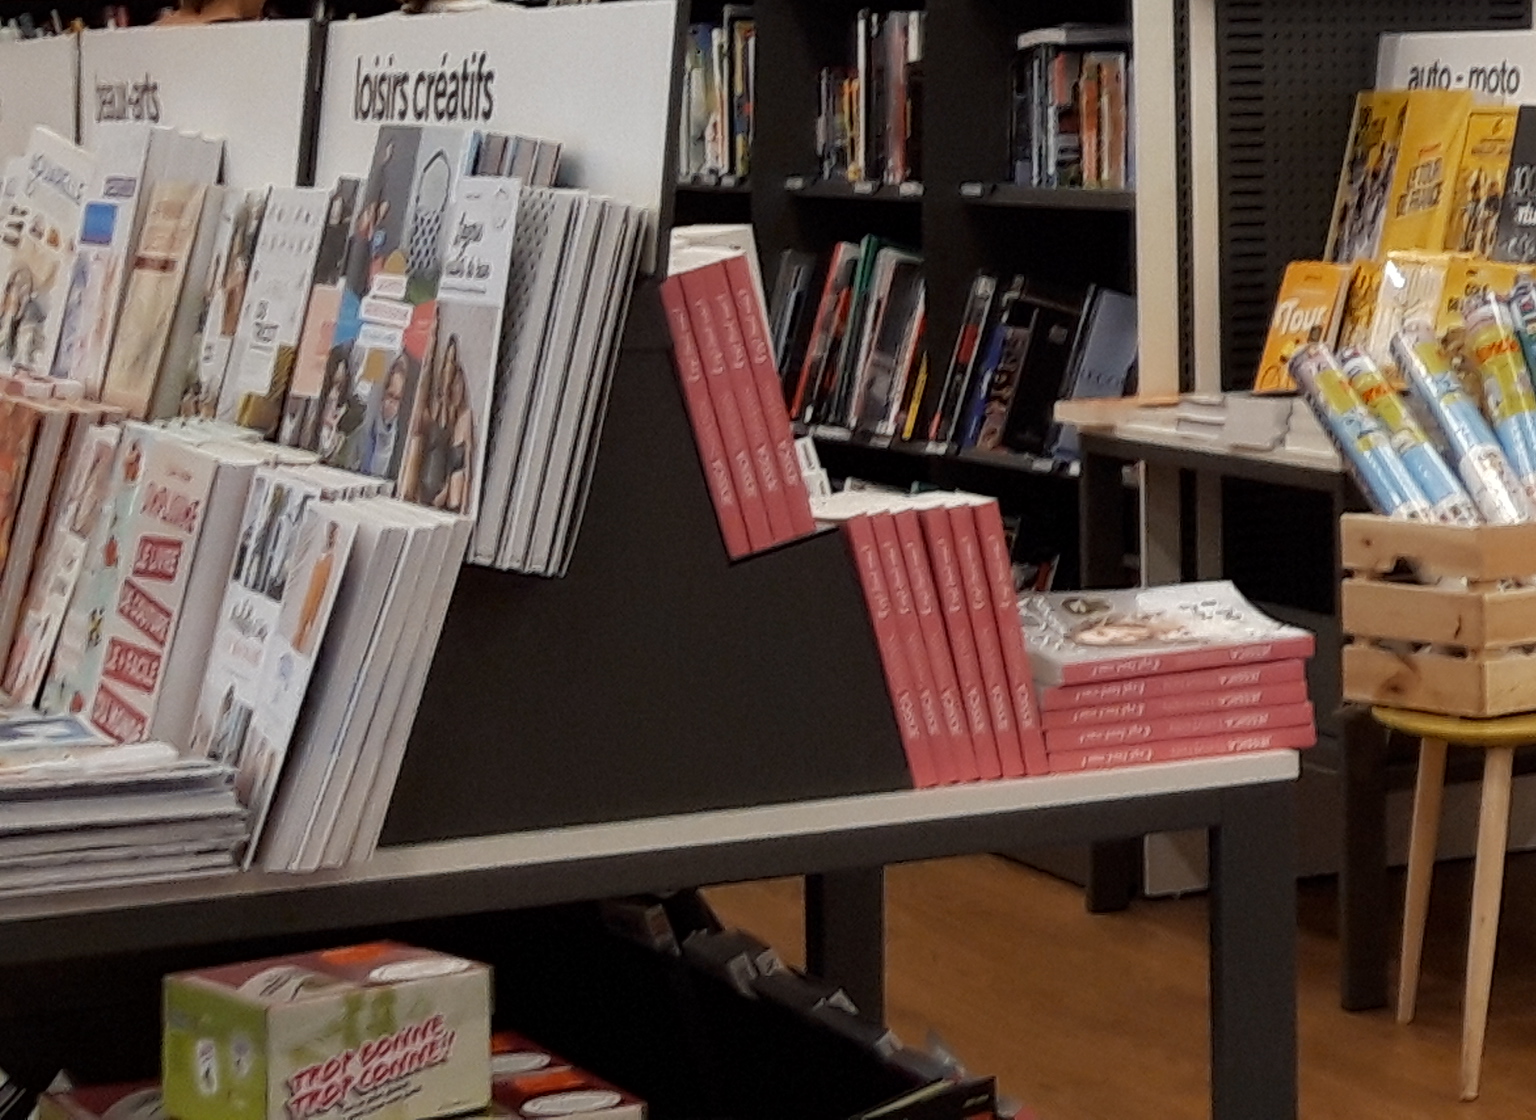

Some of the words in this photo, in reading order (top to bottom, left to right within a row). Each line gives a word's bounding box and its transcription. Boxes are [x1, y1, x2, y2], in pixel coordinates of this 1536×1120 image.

[353, 56, 410, 122] loisirs
[413, 50, 496, 121] créatifs
[1408, 63, 1451, 92] auto
[1469, 59, 1521, 92] moto
